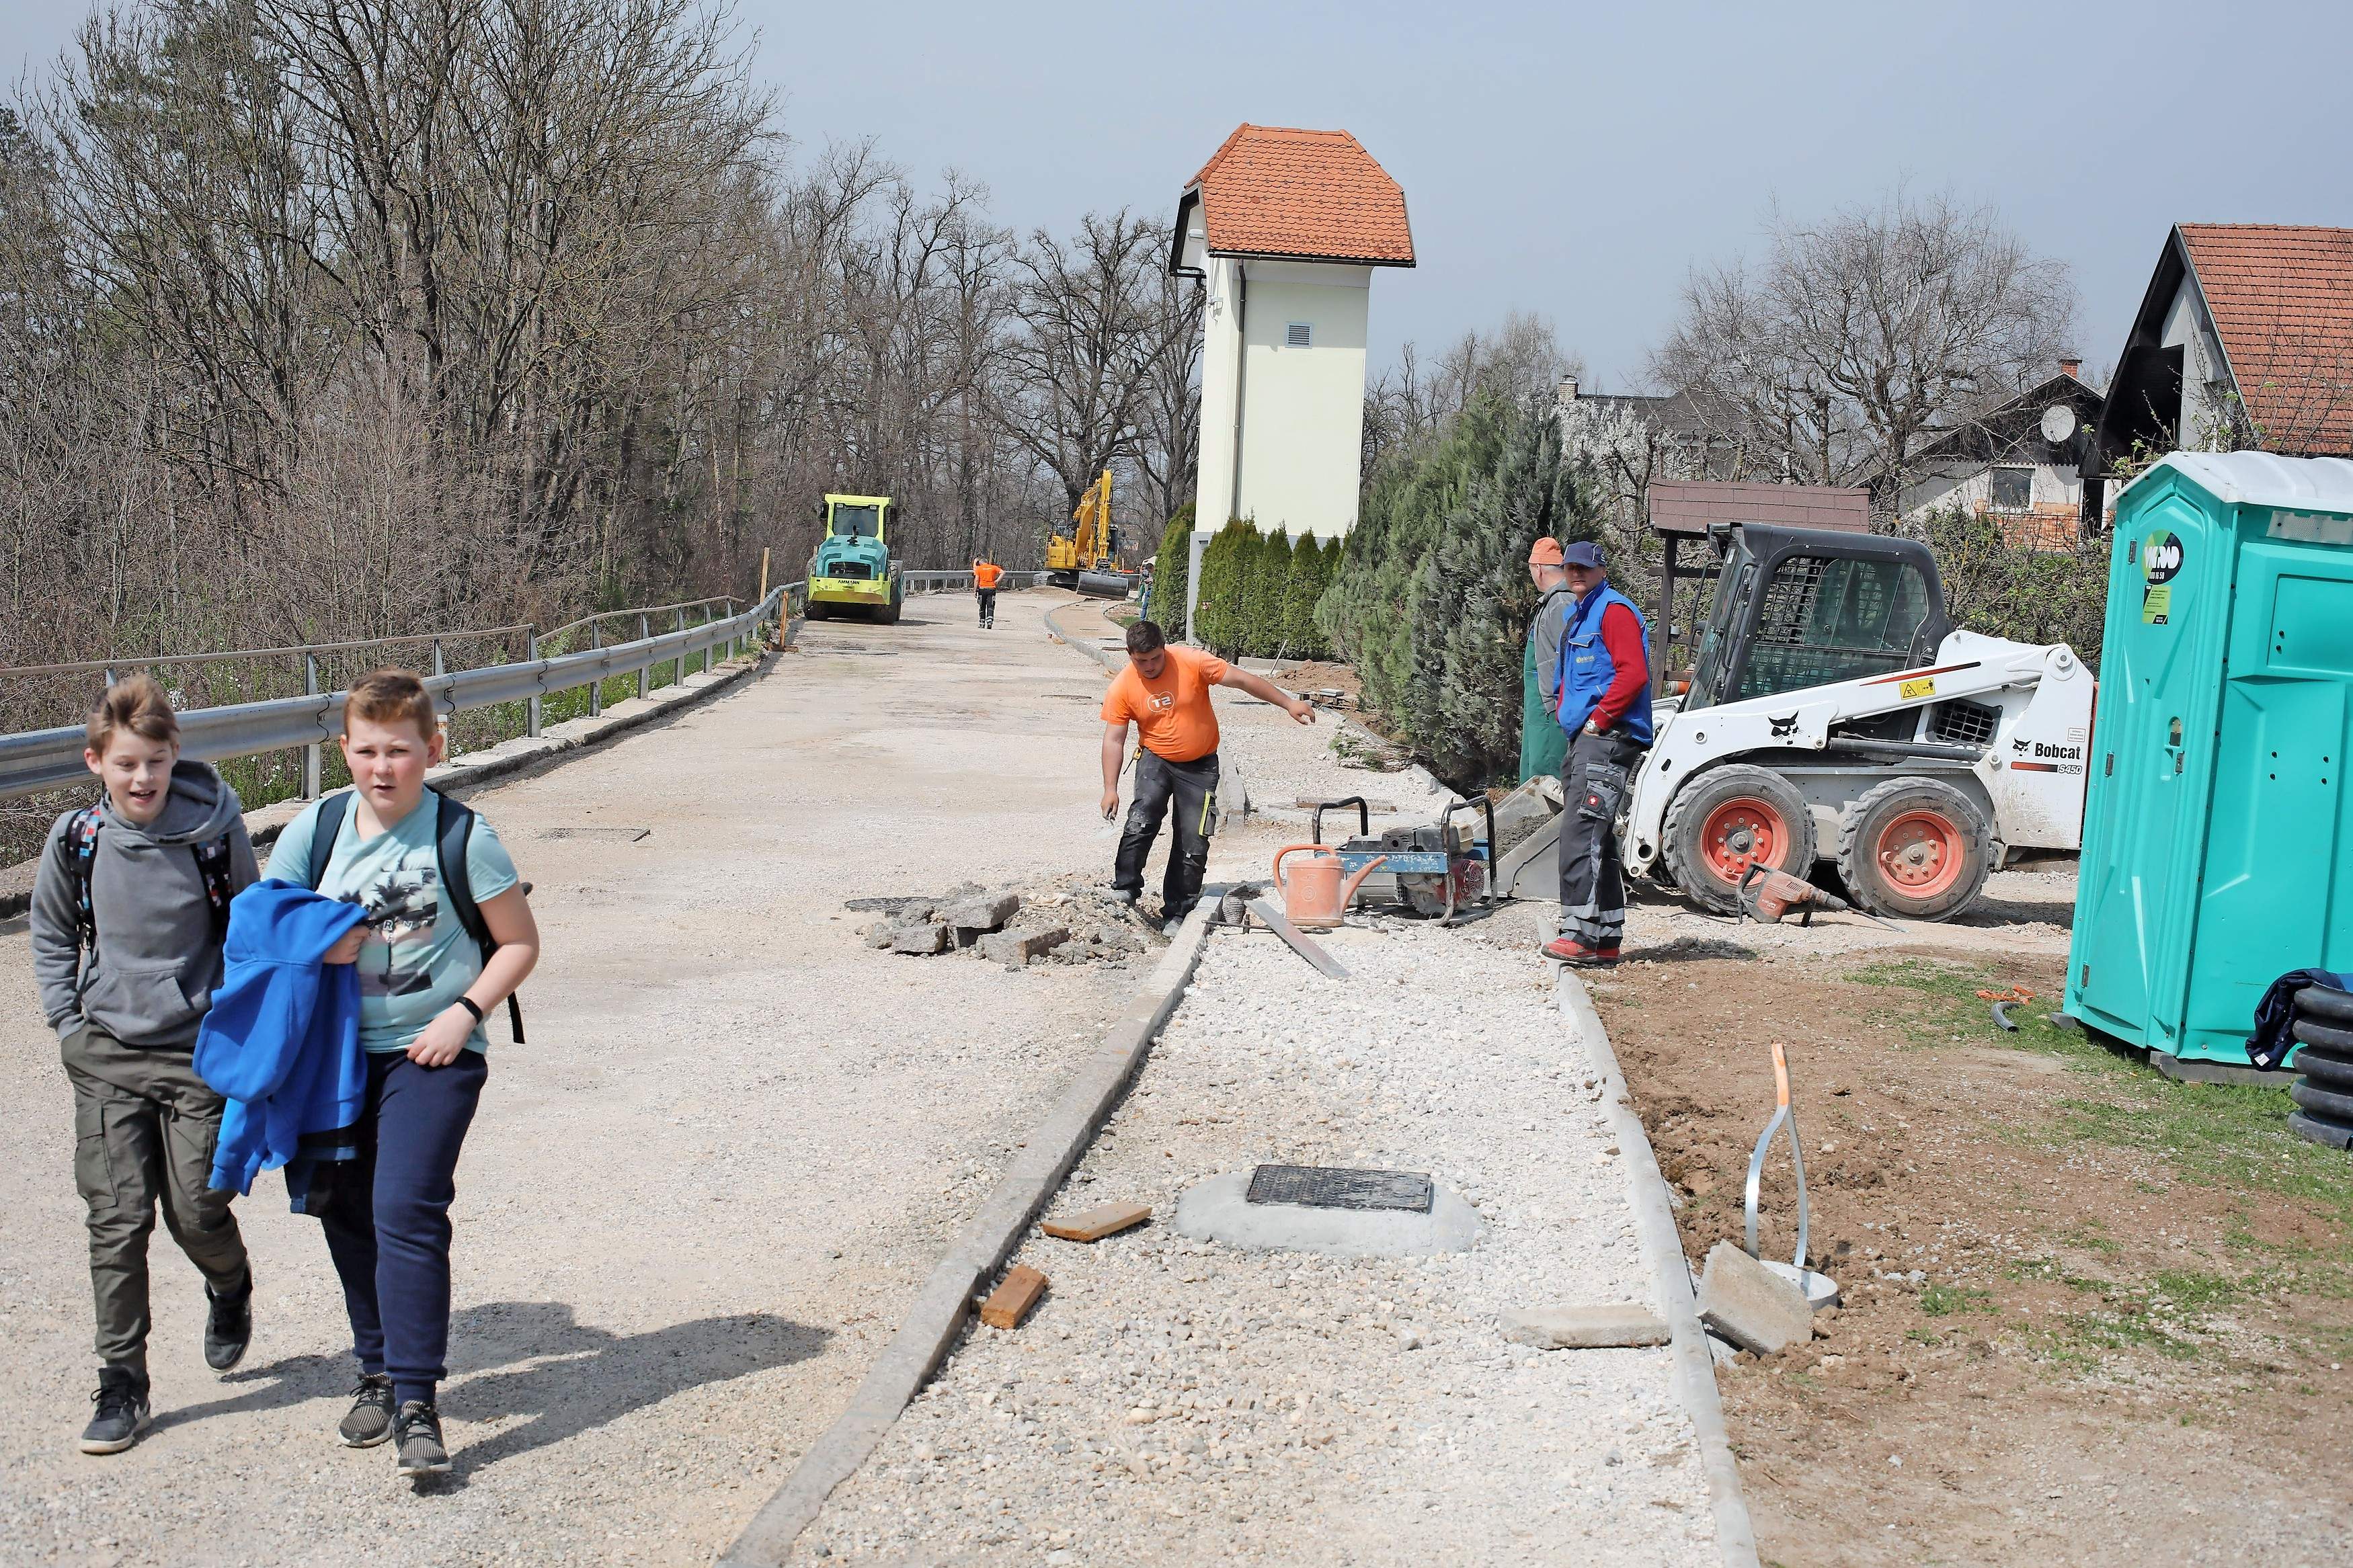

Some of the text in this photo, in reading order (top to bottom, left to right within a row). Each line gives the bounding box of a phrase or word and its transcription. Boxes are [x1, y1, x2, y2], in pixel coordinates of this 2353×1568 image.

[1152, 696, 1172, 708] T2
[2035, 743, 2081, 759] Bobcat
[2059, 764, 2083, 774] S450
